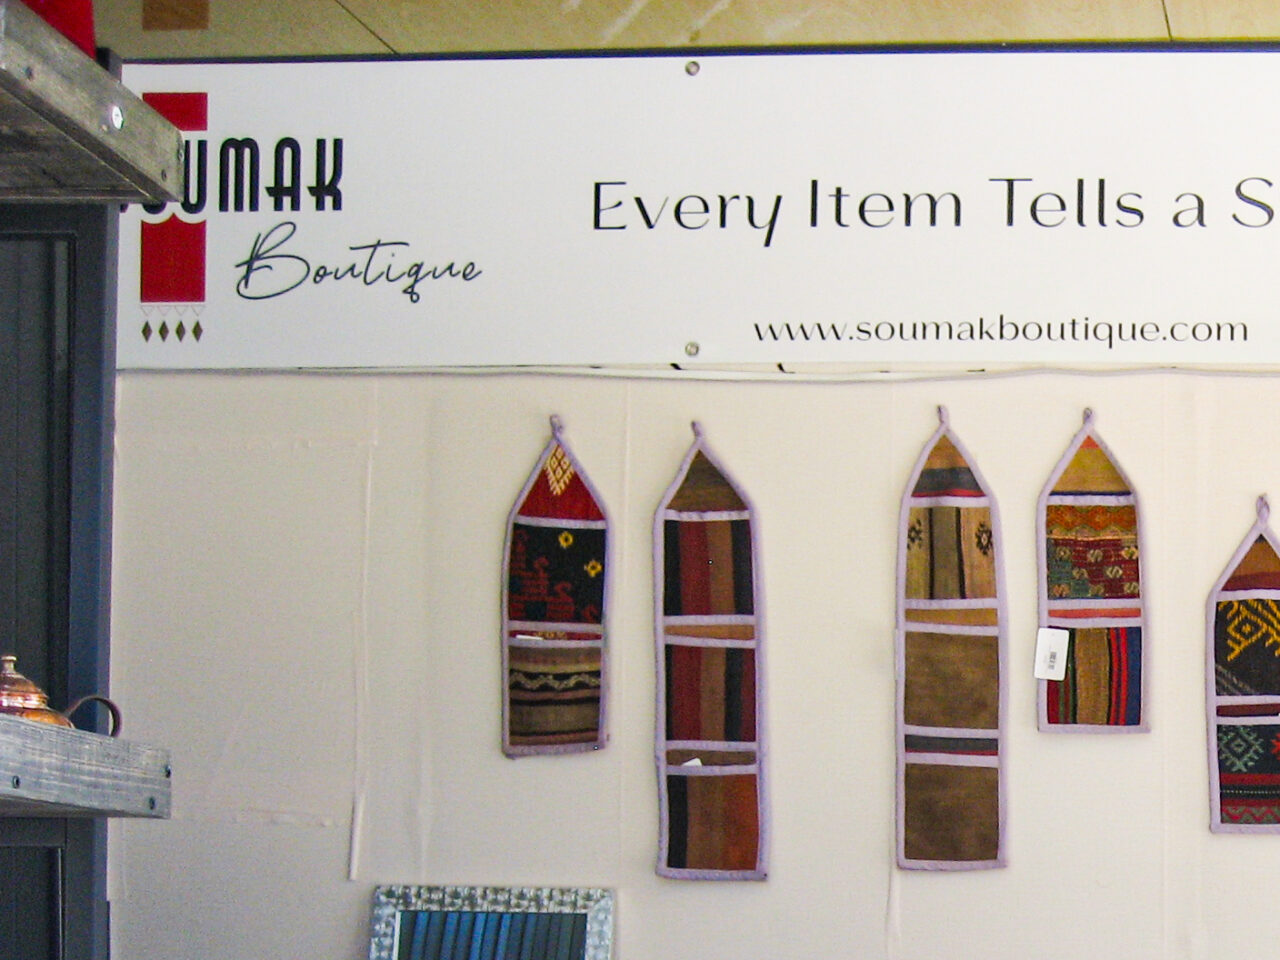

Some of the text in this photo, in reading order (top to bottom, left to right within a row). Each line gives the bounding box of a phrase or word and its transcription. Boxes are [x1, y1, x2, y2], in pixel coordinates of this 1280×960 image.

[120, 137, 343, 214] UMAK
[593, 181, 783, 248] Every
[810, 179, 961, 228] Item
[989, 178, 1144, 228] Tells
[1172, 193, 1206, 228] a
[235, 222, 482, 303] Boutique
[754, 314, 1248, 350] www.soumakboutique.com
